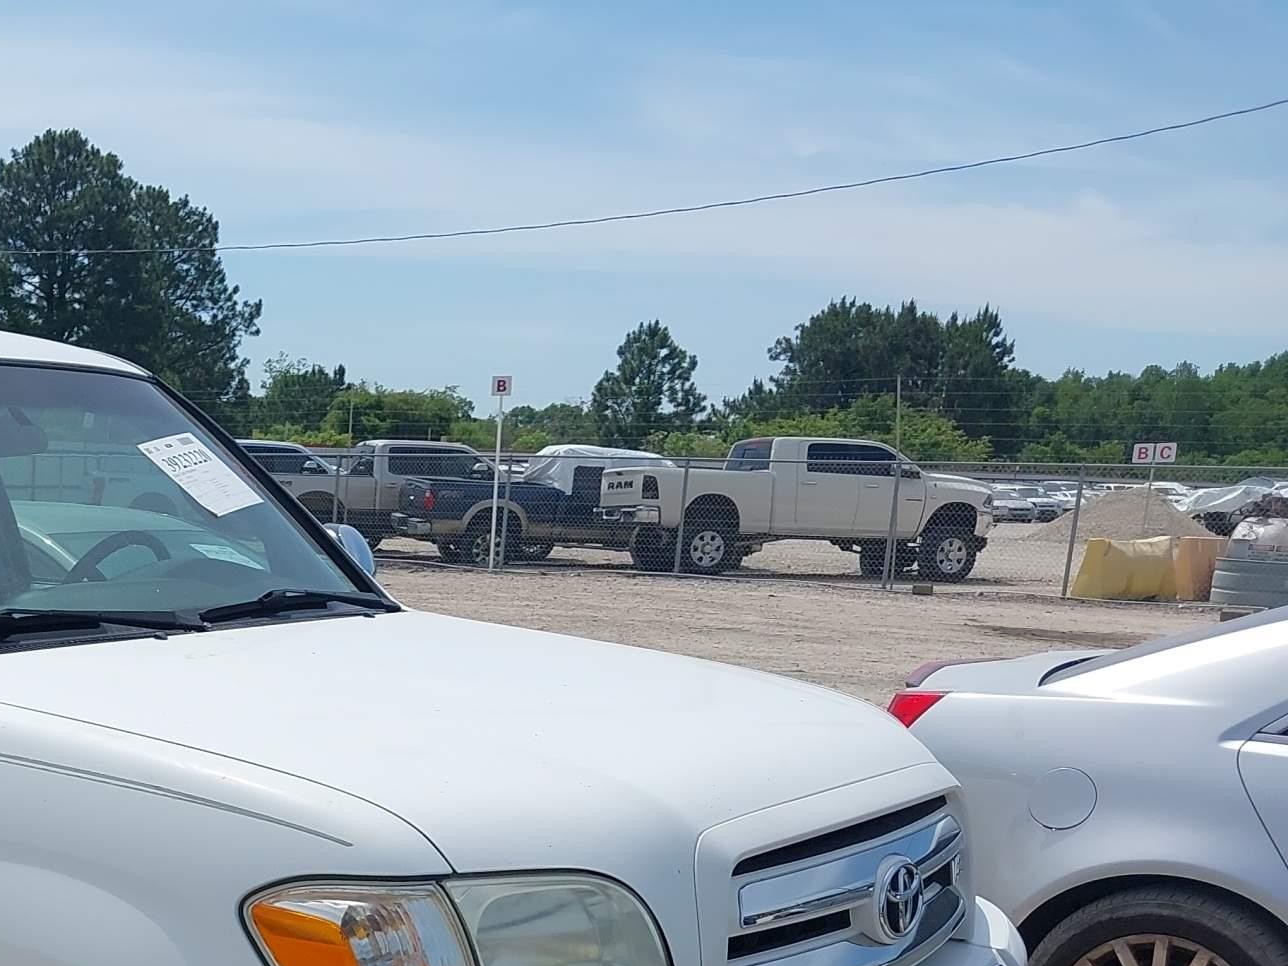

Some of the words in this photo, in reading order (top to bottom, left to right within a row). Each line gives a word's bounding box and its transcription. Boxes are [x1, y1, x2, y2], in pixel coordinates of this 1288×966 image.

[496, 379, 507, 392] B
[1137, 446, 1149, 460] B
[1160, 446, 1172, 459] C
[607, 480, 634, 490] RAM
